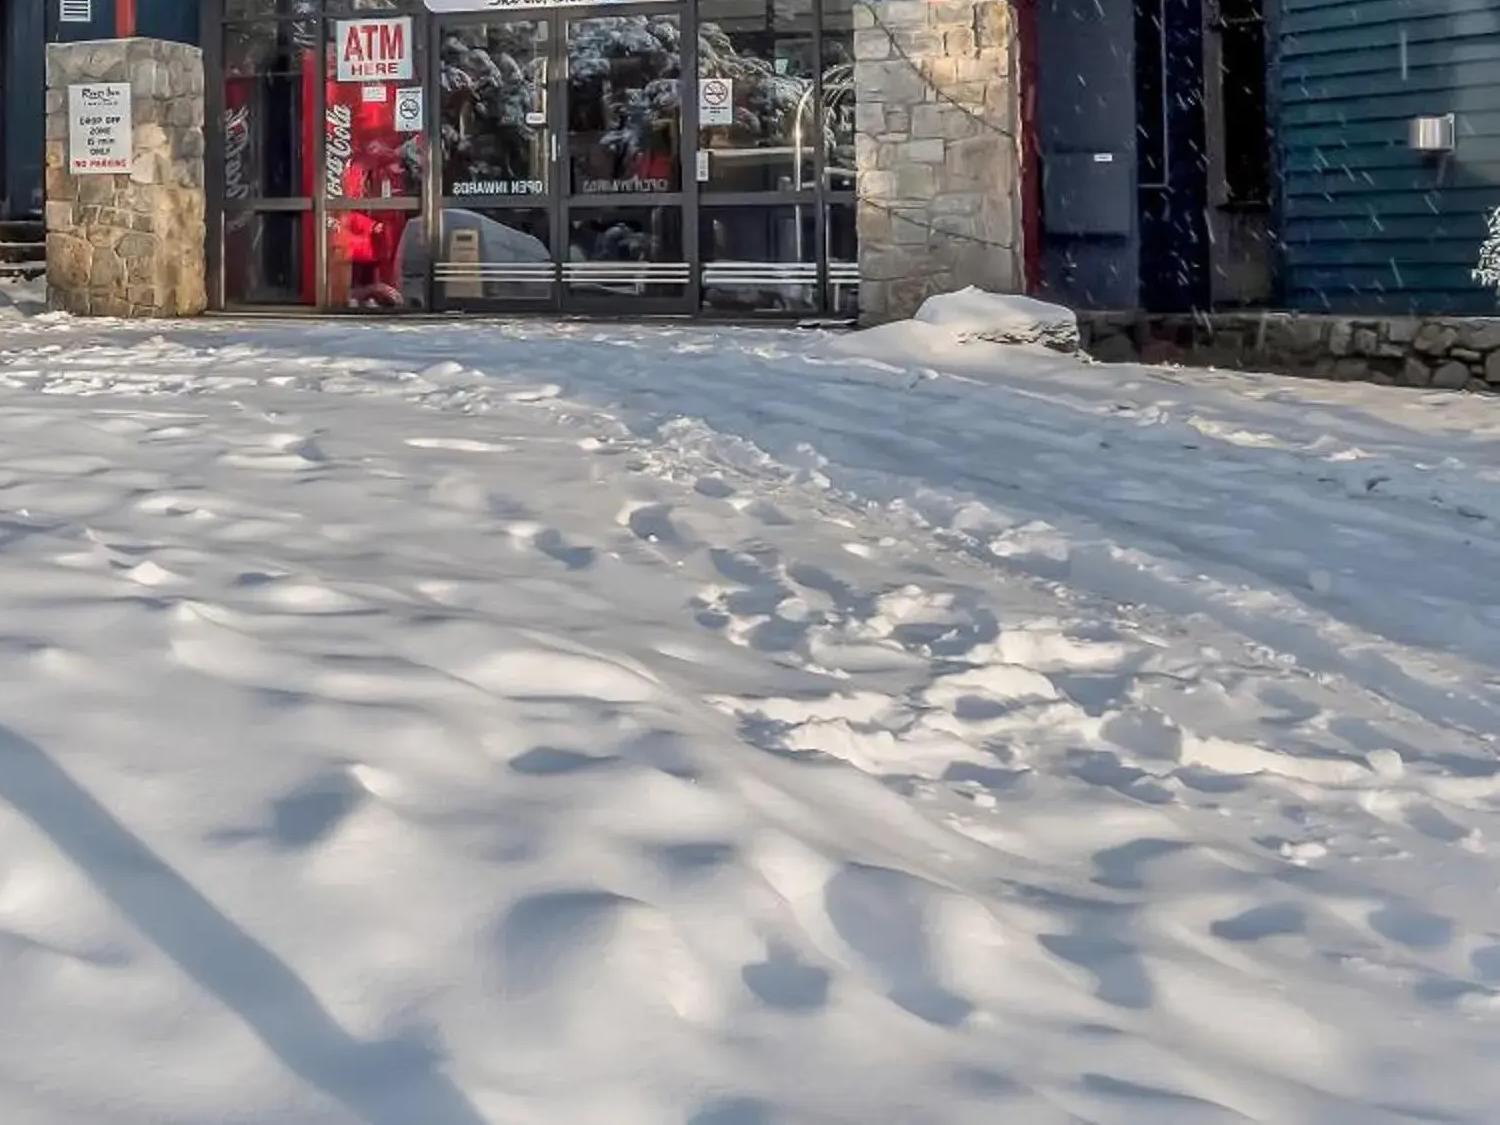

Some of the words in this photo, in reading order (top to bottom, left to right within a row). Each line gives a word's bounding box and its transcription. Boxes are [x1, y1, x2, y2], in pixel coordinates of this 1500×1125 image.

[344, 24, 404, 61] ATM
[351, 63, 399, 75] HERE
[89, 127, 111, 136] ZONE
[74, 160, 87, 168] NO
[90, 158, 127, 168] PARKING
